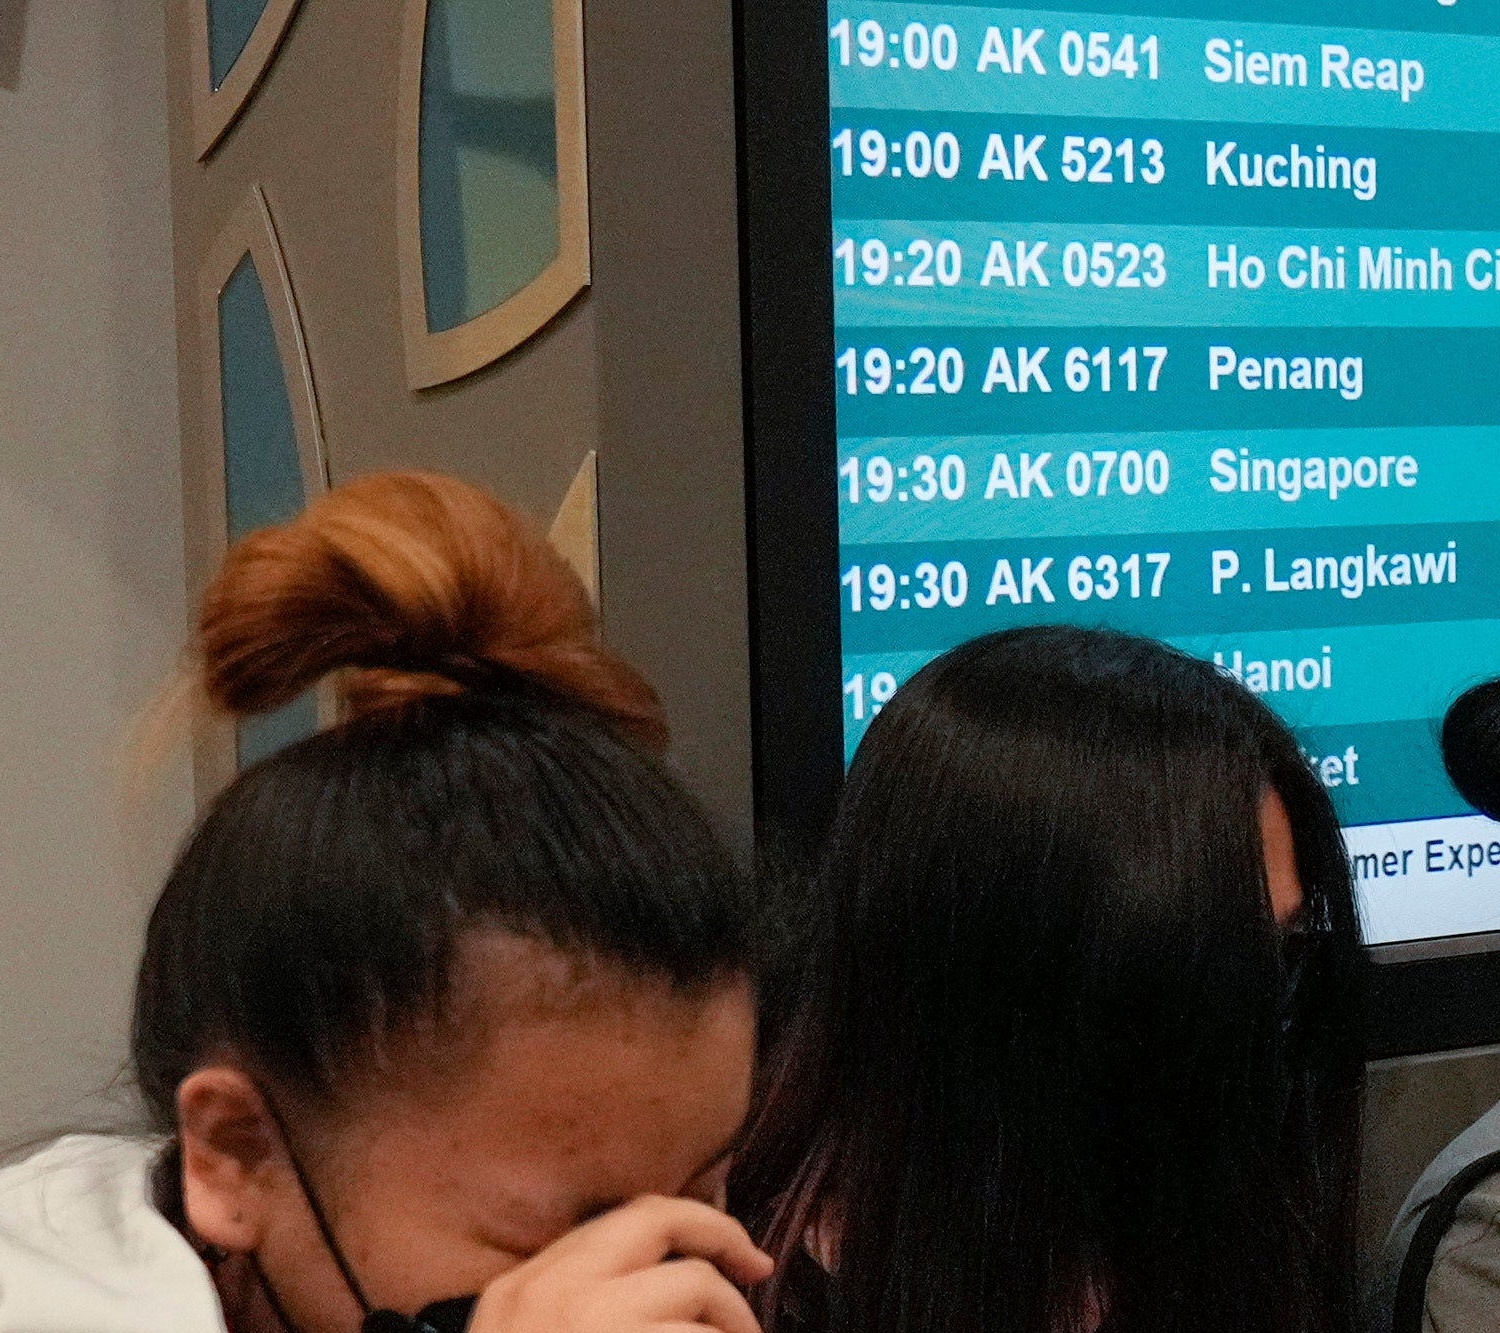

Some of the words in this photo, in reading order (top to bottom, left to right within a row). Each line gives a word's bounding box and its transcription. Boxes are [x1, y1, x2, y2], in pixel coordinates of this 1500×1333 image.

[830, 18, 958, 71] 19:00
[976, 27, 1047, 75] AK
[1059, 30, 1159, 80] 0541
[1204, 37, 1308, 87] Siem
[1321, 44, 1425, 103] Reap
[832, 128, 961, 180] 19:00
[978, 132, 1049, 182] AK
[1061, 135, 1166, 185] 5213
[1206, 140, 1377, 201] Kuching
[834, 238, 963, 287] 19:20
[980, 240, 1050, 287] AK
[1062, 241, 1167, 288] 0523
[1208, 244, 1267, 290] Ho
[1277, 245, 1346, 289] Chi
[1358, 246, 1453, 291] Minh
[836, 347, 965, 395] 19:20
[981, 346, 1052, 394] AK
[1064, 346, 1168, 392] 6117
[1209, 346, 1364, 401] Penang
[839, 454, 967, 504] 19:30
[984, 452, 1055, 500] AK
[1066, 449, 1170, 497] 0700
[1209, 447, 1419, 503] Singapore
[841, 561, 969, 612] 19:30
[985, 557, 1056, 606] AK
[1067, 552, 1171, 601] 6317
[1211, 549, 1251, 595] P.
[1265, 540, 1457, 600] Langkawi
